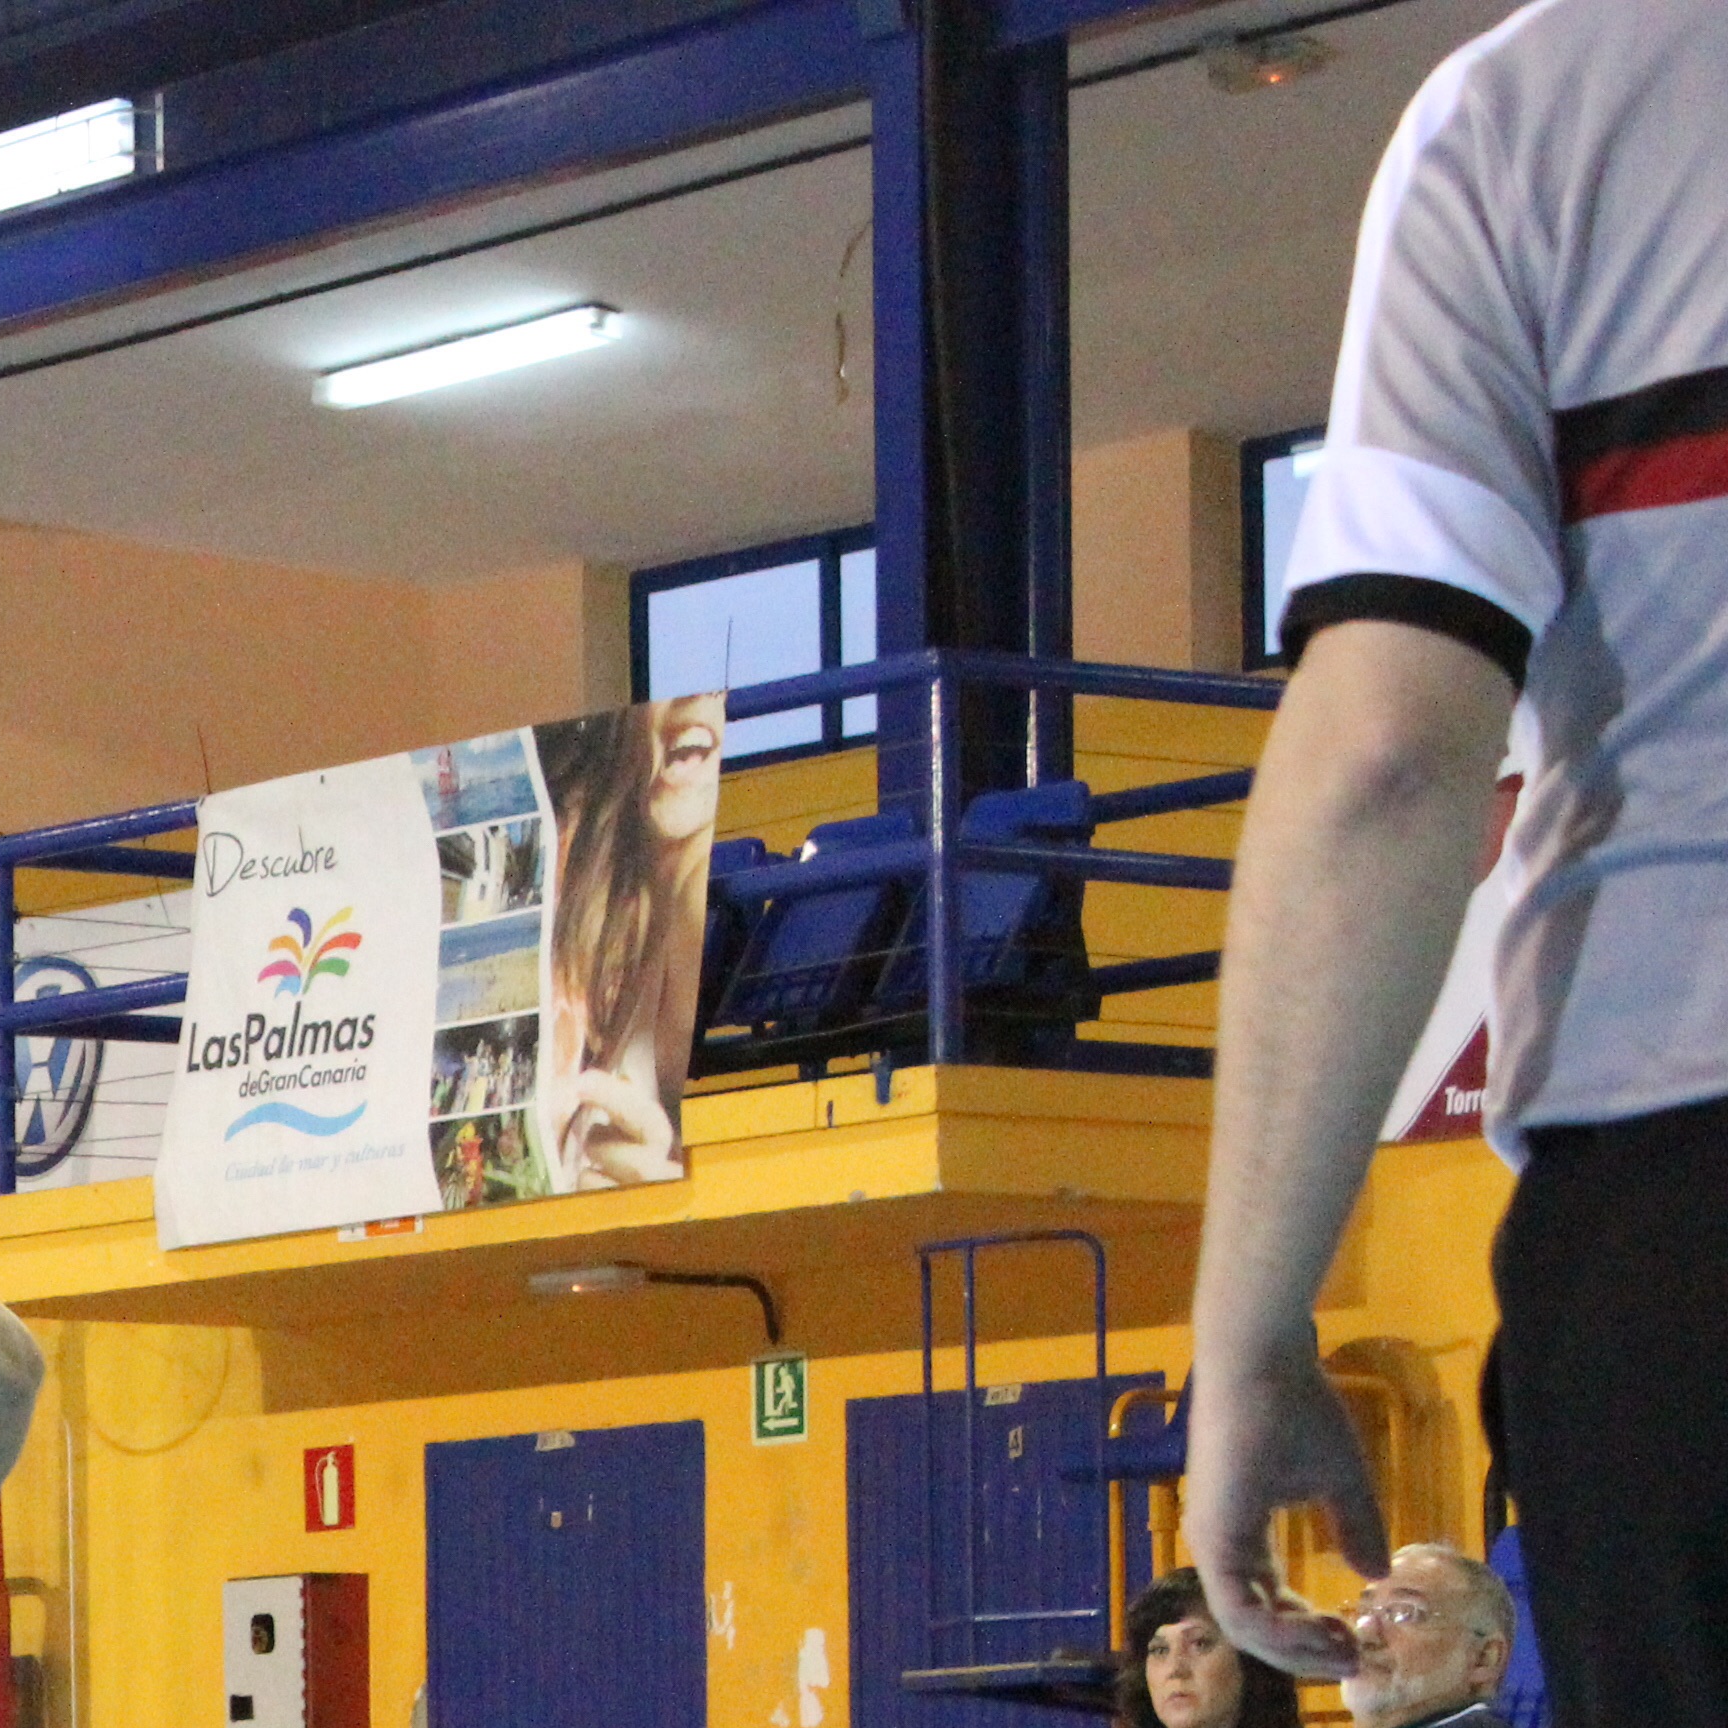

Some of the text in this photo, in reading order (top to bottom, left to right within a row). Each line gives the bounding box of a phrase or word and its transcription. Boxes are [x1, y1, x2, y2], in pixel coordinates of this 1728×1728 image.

[203, 825, 338, 898] Descubre
[187, 1001, 377, 1073] LasPalmas
[238, 1058, 367, 1099] deGranCanaria
